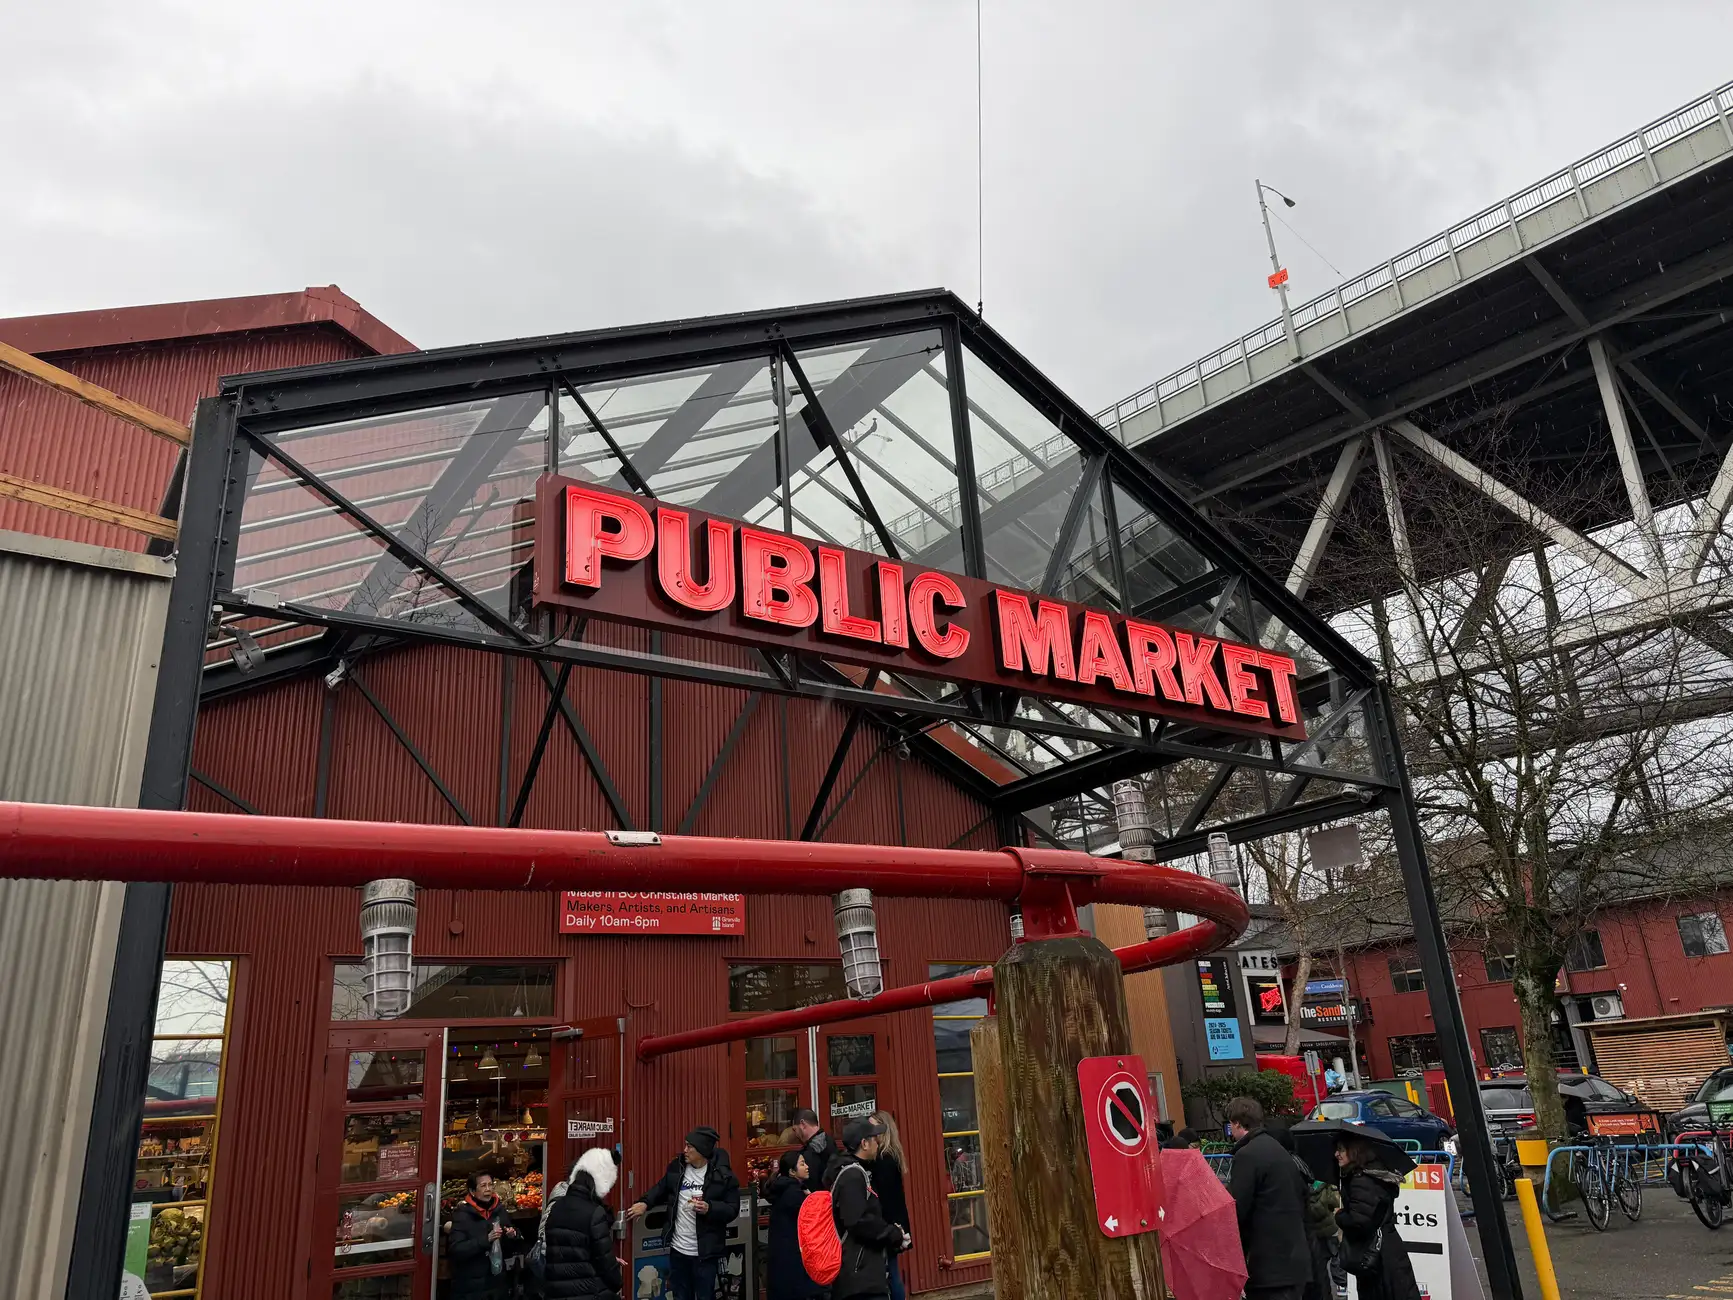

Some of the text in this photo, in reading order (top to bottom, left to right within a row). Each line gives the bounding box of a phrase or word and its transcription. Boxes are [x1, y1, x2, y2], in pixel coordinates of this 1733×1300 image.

[563, 484, 1299, 724] PUBLIC MARKET
[566, 900, 735, 915] Makers, Artists, and Artisans
[566, 914, 660, 928] Daily 10am-6pm
[831, 1107, 848, 1115] PUBLIC
[848, 1101, 874, 1111] MARKET
[1408, 1170, 1441, 1184] us
